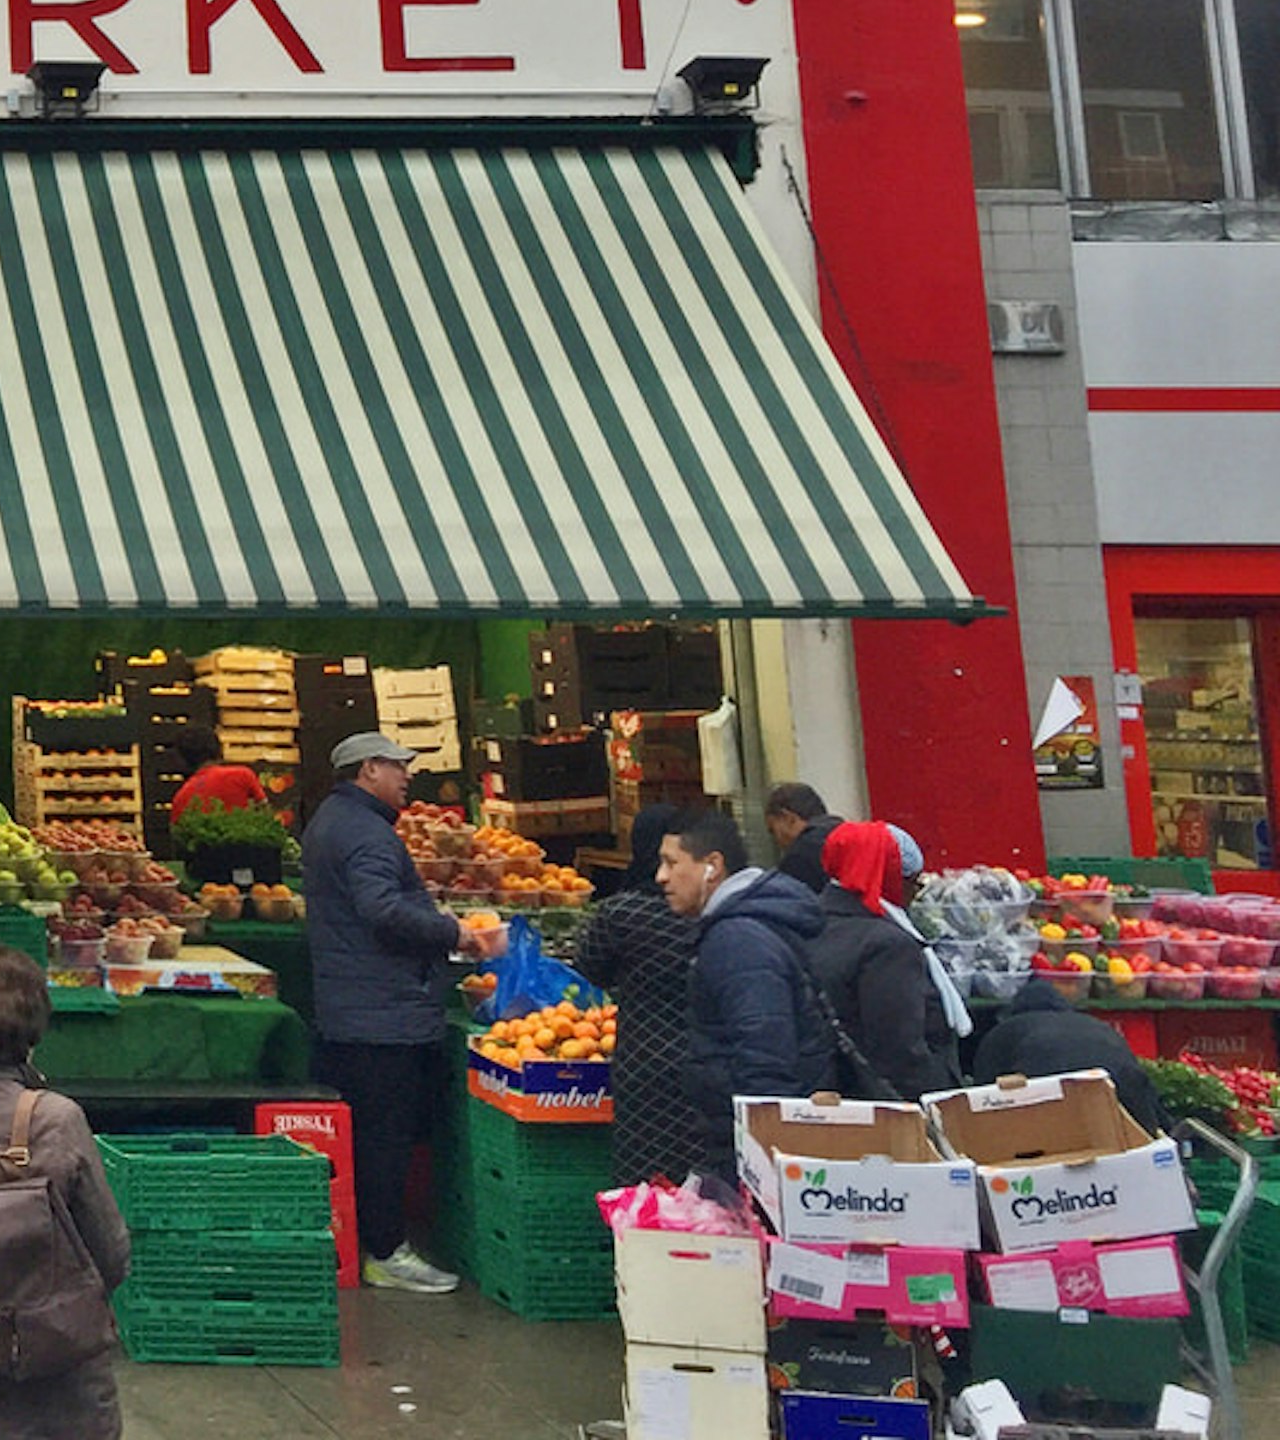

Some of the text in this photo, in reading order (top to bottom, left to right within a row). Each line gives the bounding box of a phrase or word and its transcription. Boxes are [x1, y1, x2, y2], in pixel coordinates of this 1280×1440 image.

[535, 1086, 606, 1109] nobel
[800, 1186, 906, 1214] Melinda
[1011, 1182, 1117, 1220] Melinda
